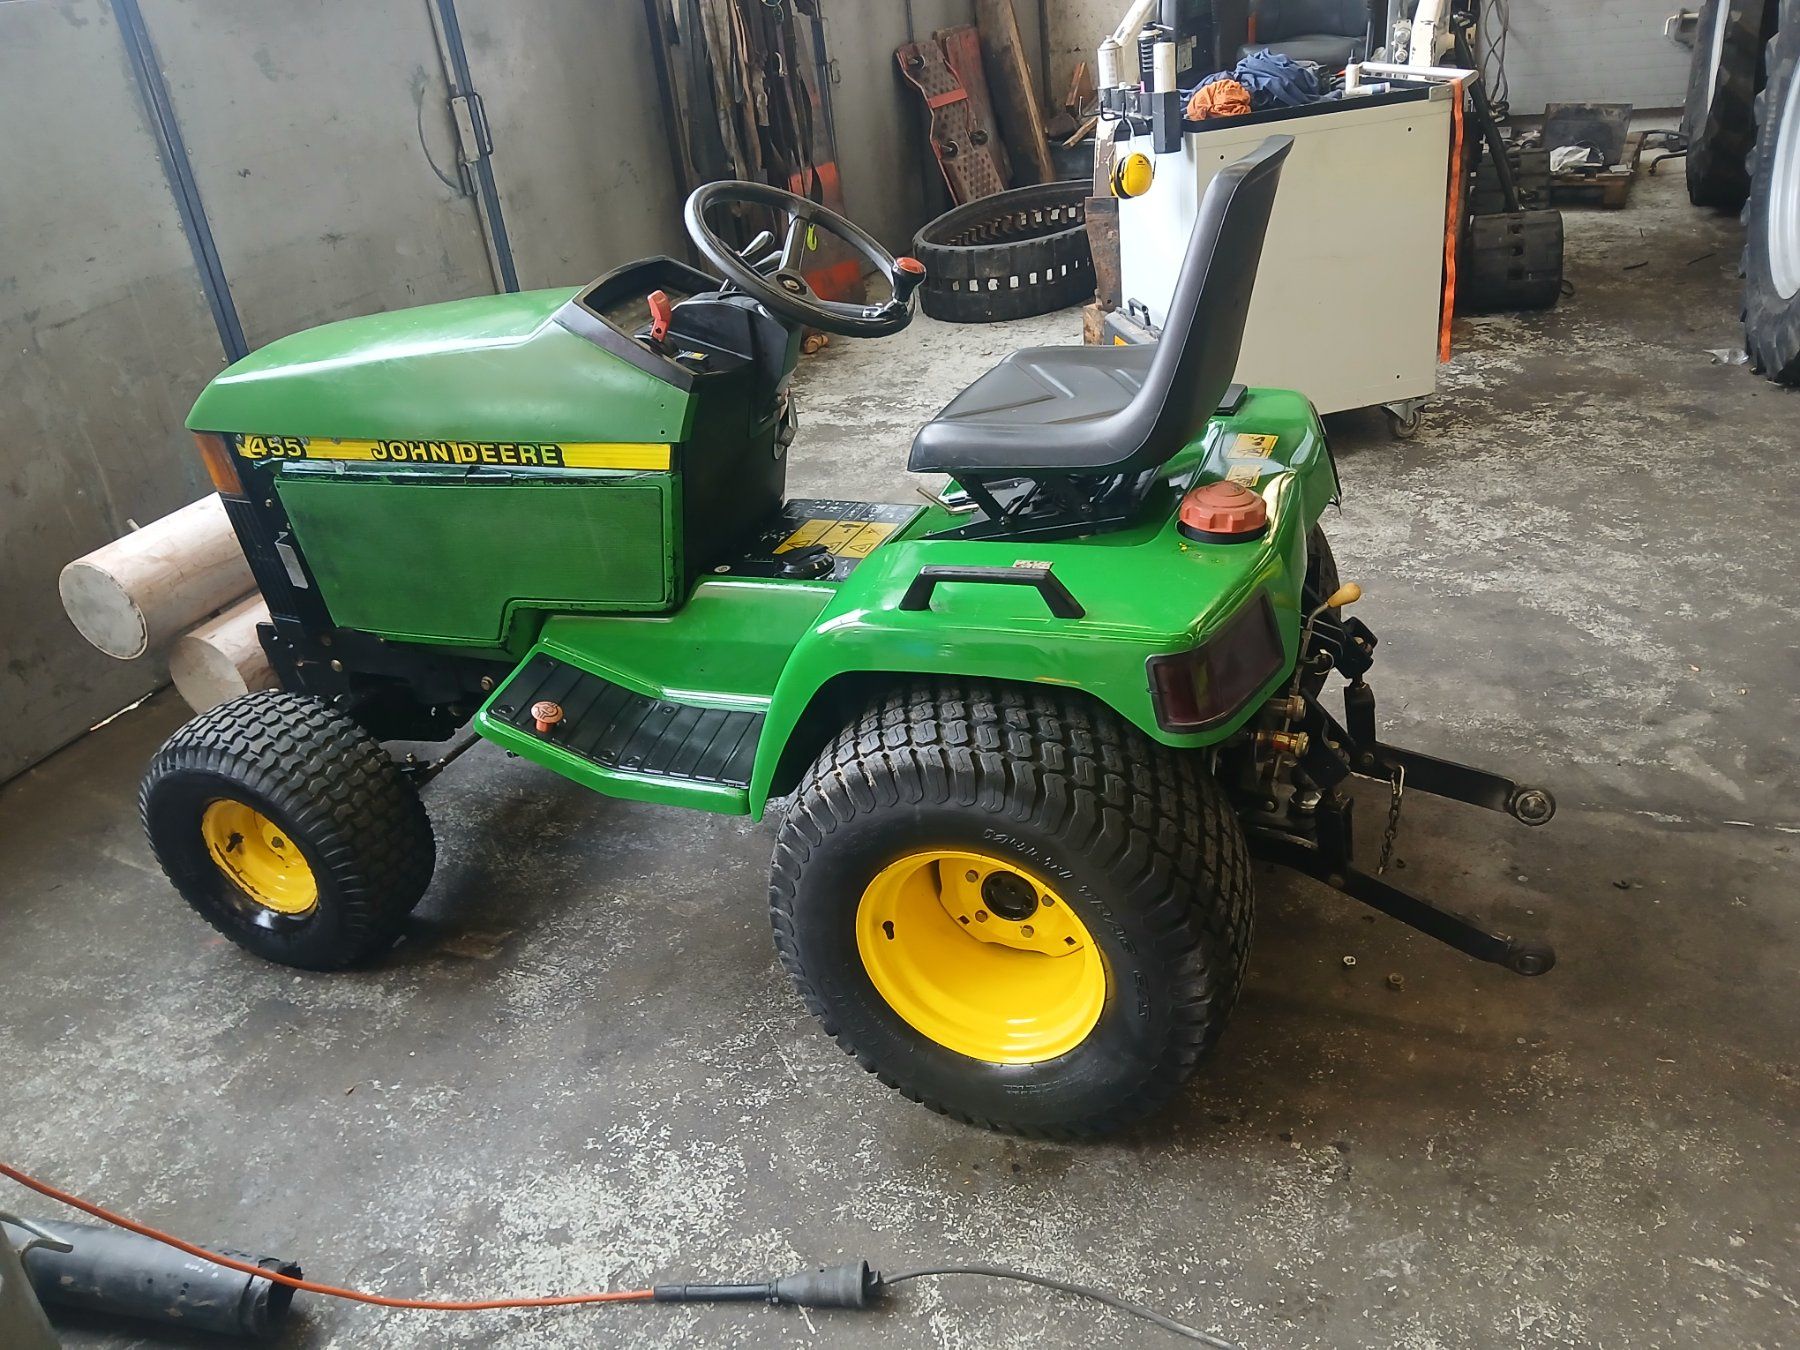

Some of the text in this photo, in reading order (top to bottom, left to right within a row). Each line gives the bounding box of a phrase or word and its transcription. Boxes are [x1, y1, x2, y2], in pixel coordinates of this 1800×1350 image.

[250, 437, 302, 457] 455
[372, 440, 560, 465] JOHN DEERE
